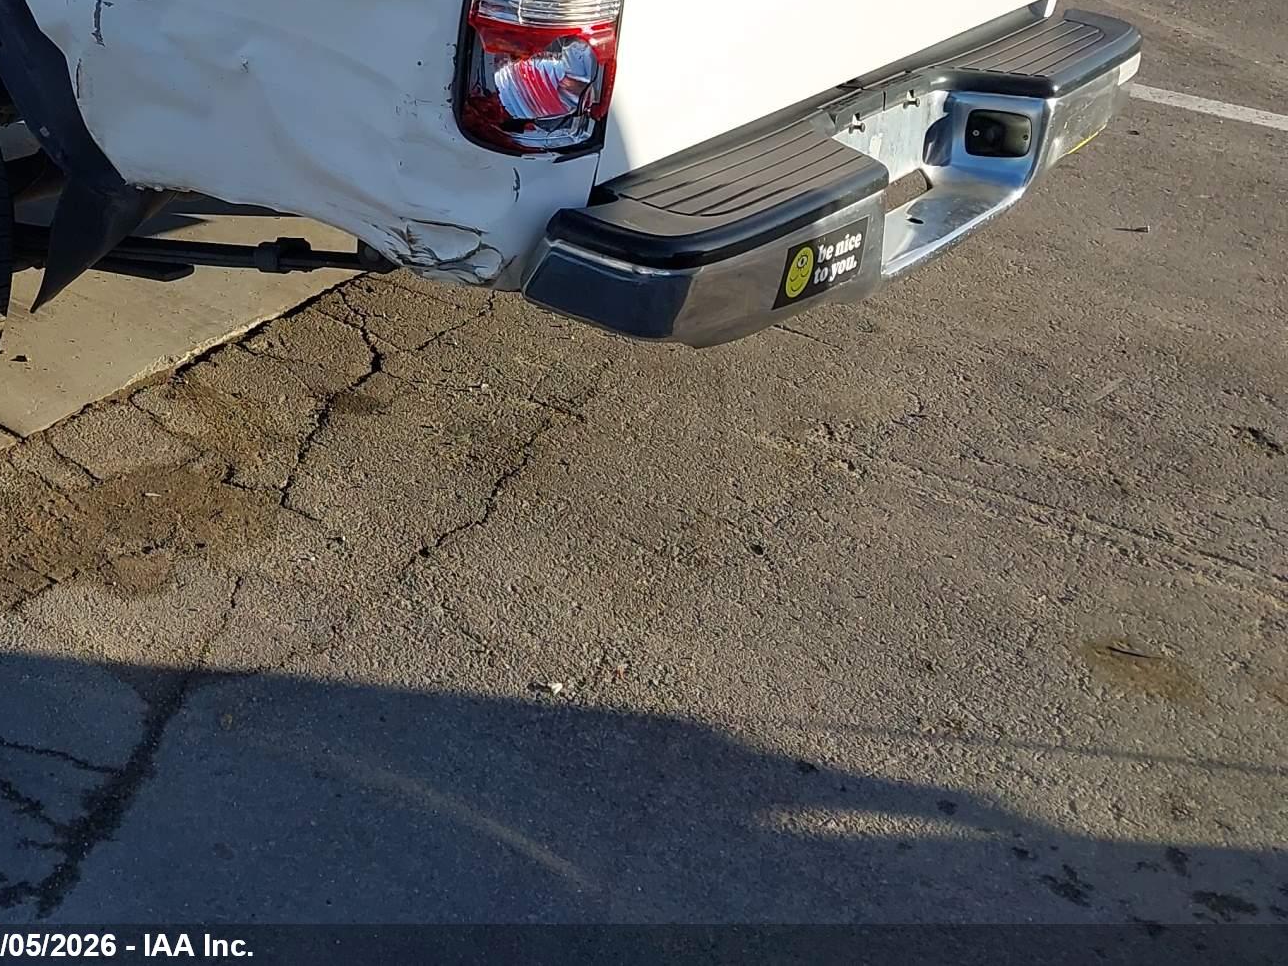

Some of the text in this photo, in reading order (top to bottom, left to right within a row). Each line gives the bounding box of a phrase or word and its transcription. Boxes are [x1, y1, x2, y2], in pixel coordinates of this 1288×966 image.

[817, 233, 862, 263] be nice
[814, 267, 829, 284] to
